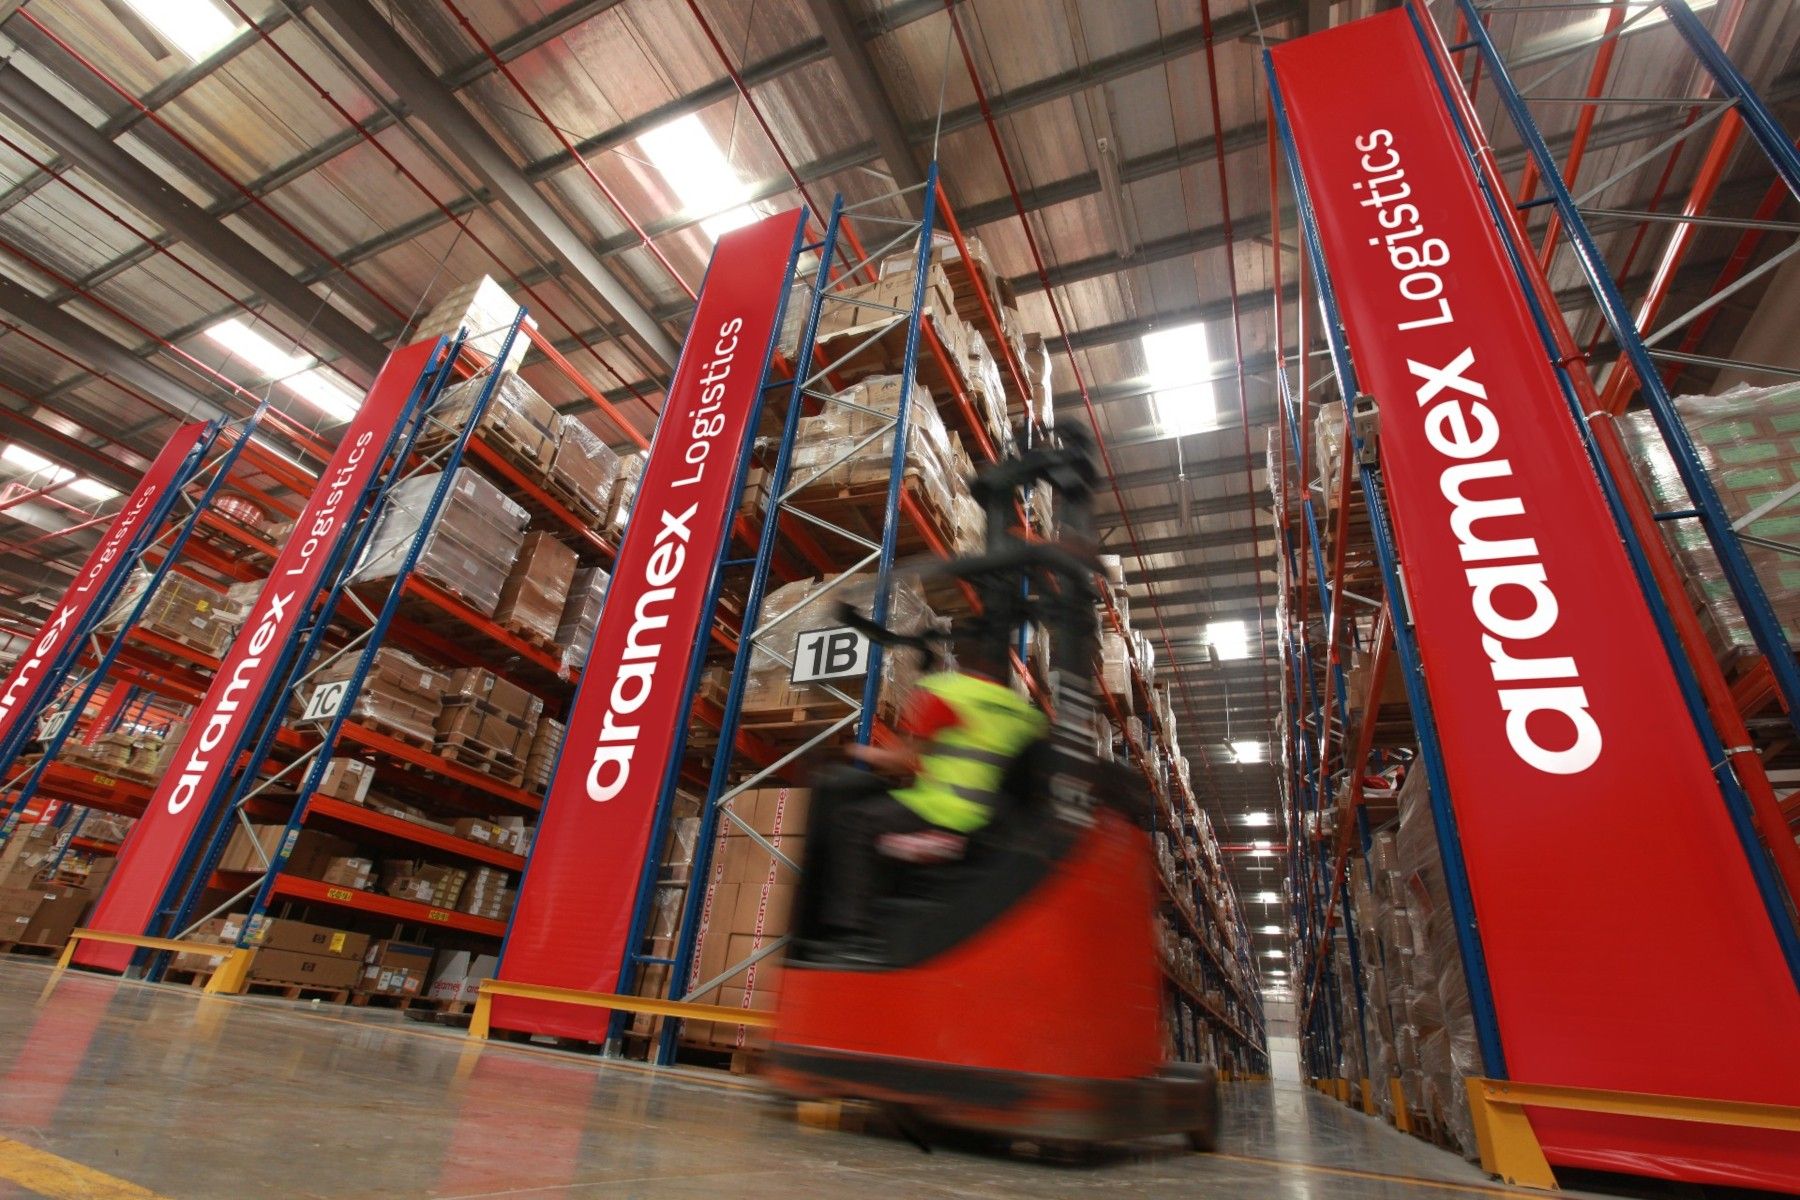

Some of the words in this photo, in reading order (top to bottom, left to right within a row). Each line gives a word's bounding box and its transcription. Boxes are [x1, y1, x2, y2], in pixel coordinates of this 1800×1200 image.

[1354, 128, 1454, 331] Logistics
[77, 485, 156, 592] Logistics
[168, 590, 295, 815] aramex
[286, 431, 373, 576] Logistics
[586, 501, 699, 803] aramex
[671, 317, 743, 488] Logistics
[1406, 346, 1602, 775] aramex
[311, 684, 342, 716] 1C
[807, 631, 859, 676] 1B
